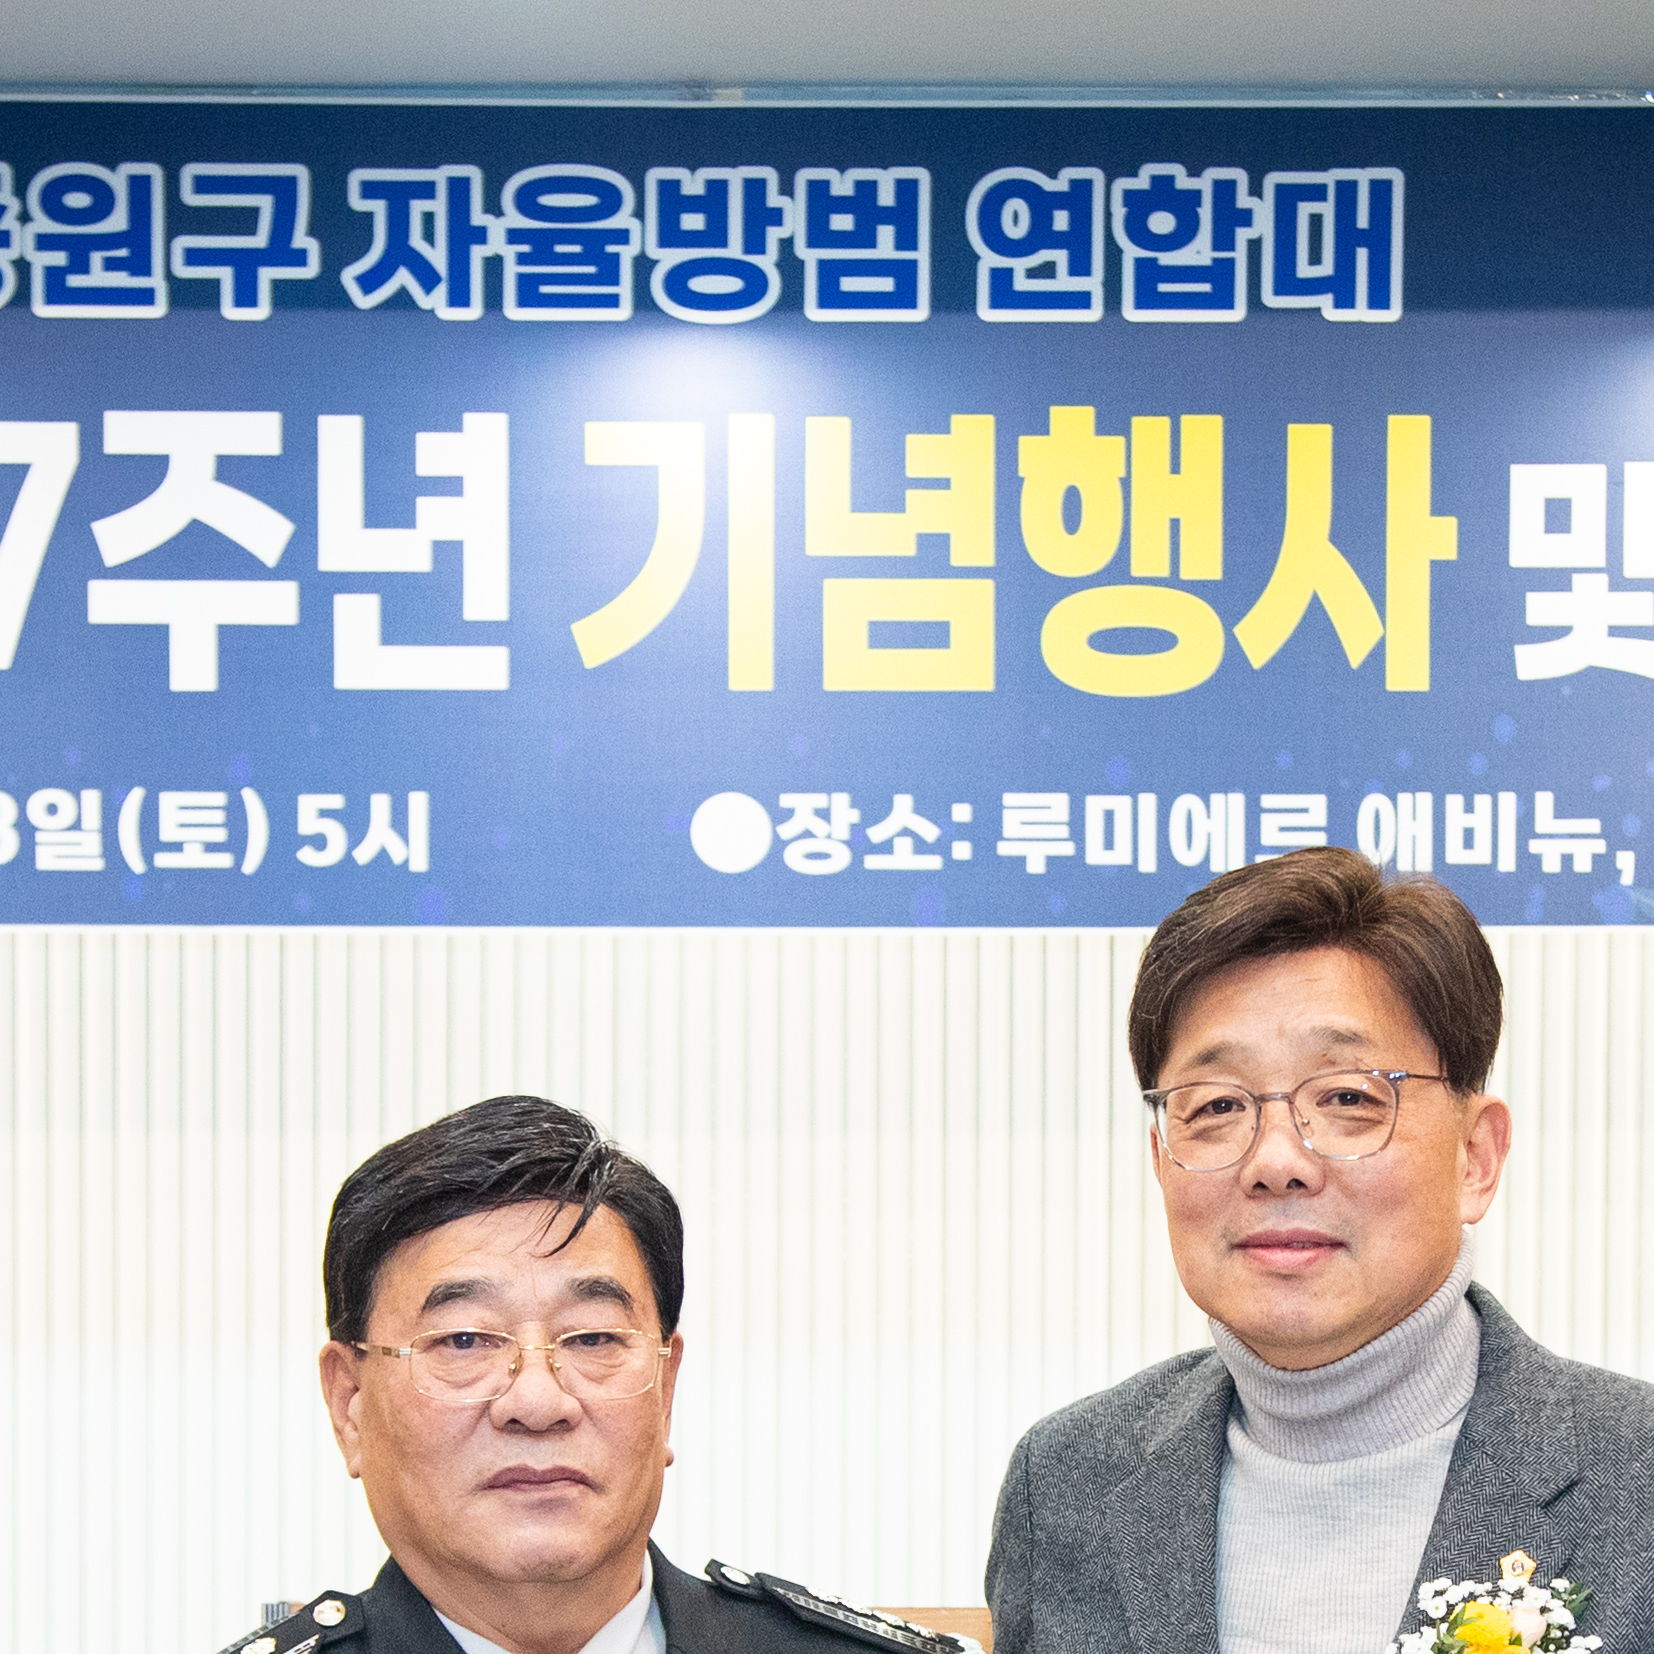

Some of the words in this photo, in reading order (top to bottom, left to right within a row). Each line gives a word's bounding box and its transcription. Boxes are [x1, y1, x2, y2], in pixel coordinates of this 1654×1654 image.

[341, 164, 929, 323] 자율방범
[966, 164, 1404, 323] 연합대
[569, 405, 1456, 696] 기념행사
[295, 790, 430, 873] 5시
[996, 791, 1327, 874] 루미에르
[1357, 791, 1635, 886] 애비뉴,
